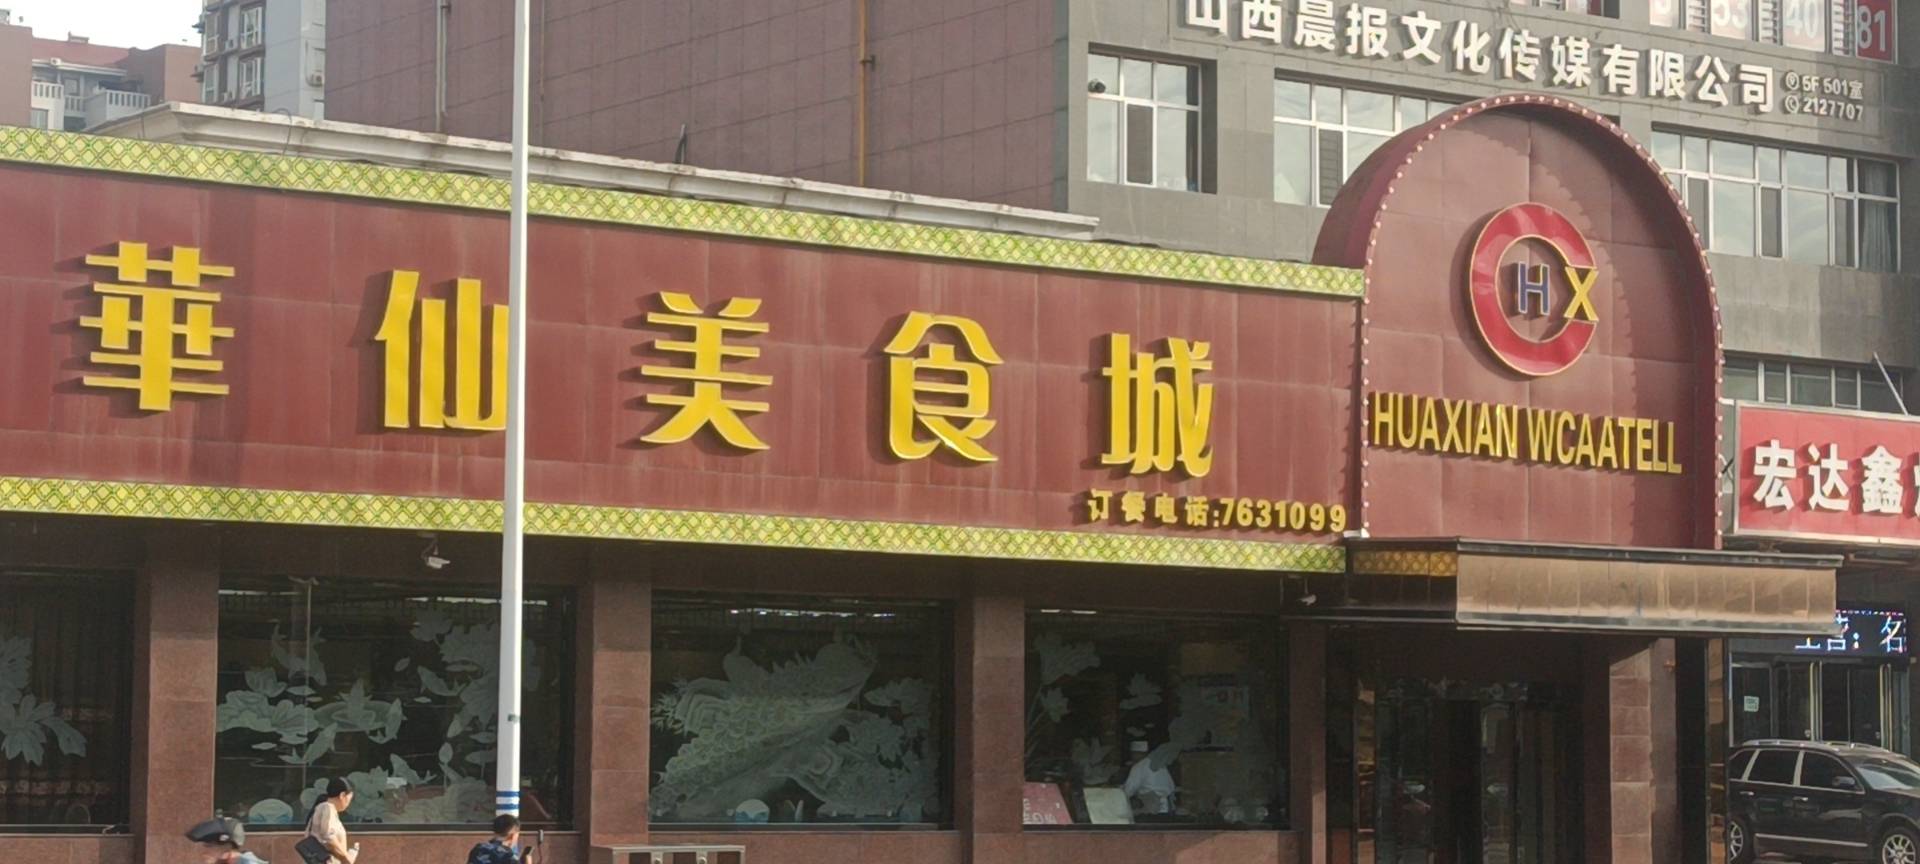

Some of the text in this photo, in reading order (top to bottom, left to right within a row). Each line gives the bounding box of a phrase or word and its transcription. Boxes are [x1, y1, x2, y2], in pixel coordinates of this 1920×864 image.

[1186, 0, 1774, 113] 山西晨报文化传媒有限公司
[1857, 5, 1886, 52] 81
[1802, 75, 1863, 100] 5F 501室
[1803, 97, 1863, 120] 2127707
[1373, 391, 1683, 474] HUAXIAN WCAATELL
[1753, 439, 1920, 521] 宏达鑫
